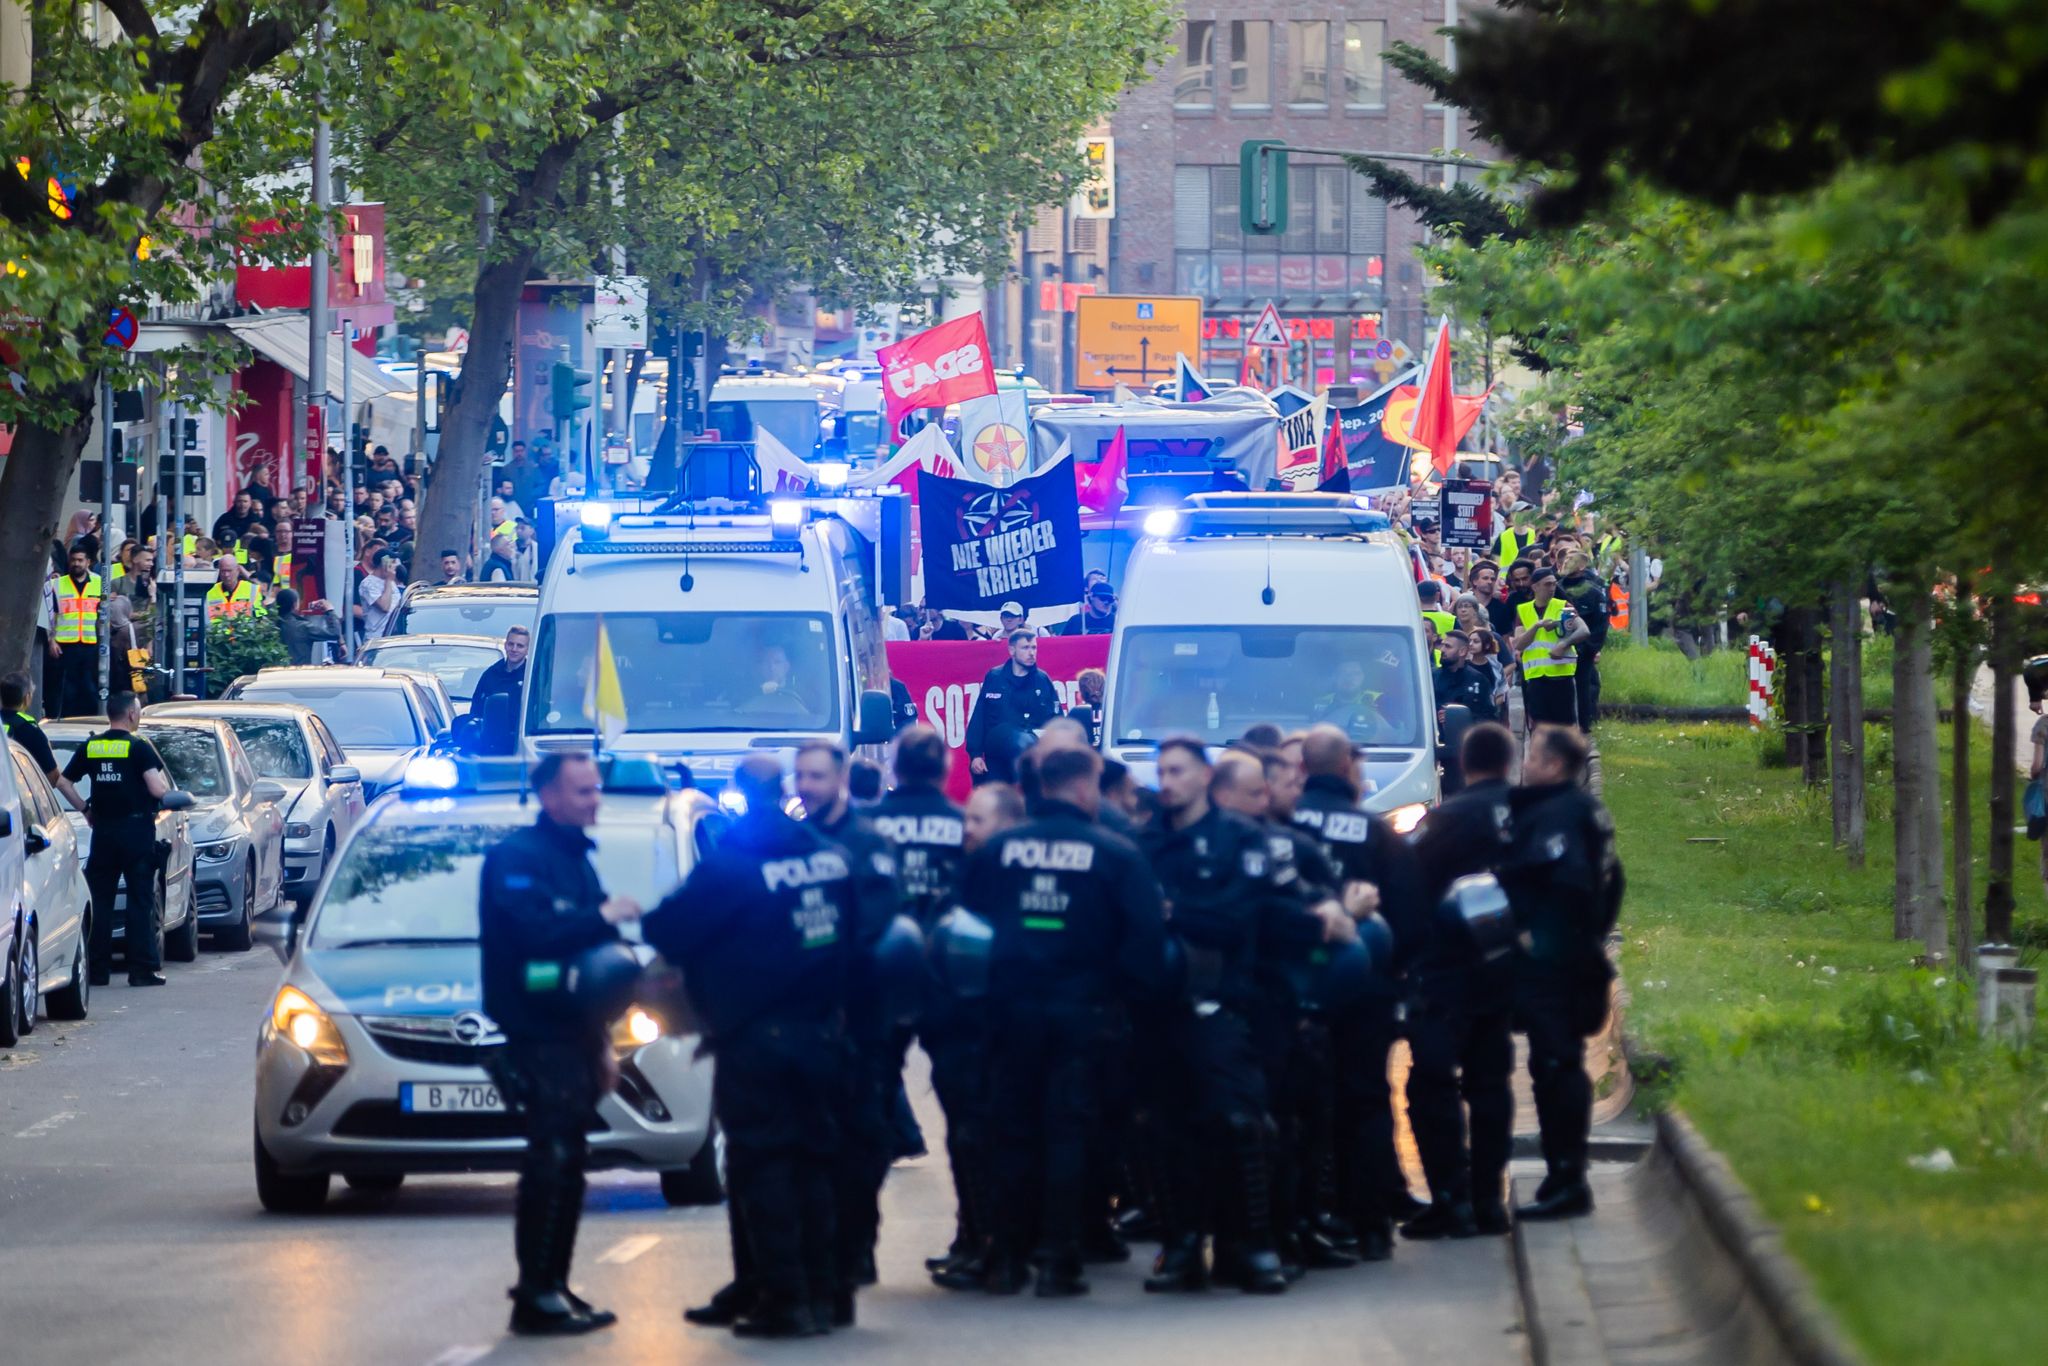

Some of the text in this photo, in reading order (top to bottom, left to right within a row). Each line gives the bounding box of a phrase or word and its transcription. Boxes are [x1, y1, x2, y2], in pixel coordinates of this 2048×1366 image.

[1111, 321, 1180, 333] Reinickendorf
[951, 540, 982, 571] NIE
[984, 519, 1057, 566] WIEDER
[976, 555, 1039, 598] KRIEG!
[90, 743, 127, 754] POLIZEI
[101, 762, 113, 772] BE
[874, 816, 963, 846] POLIZEI
[1001, 838, 1095, 872] POLIZEI
[762, 853, 849, 892] POLIZEI
